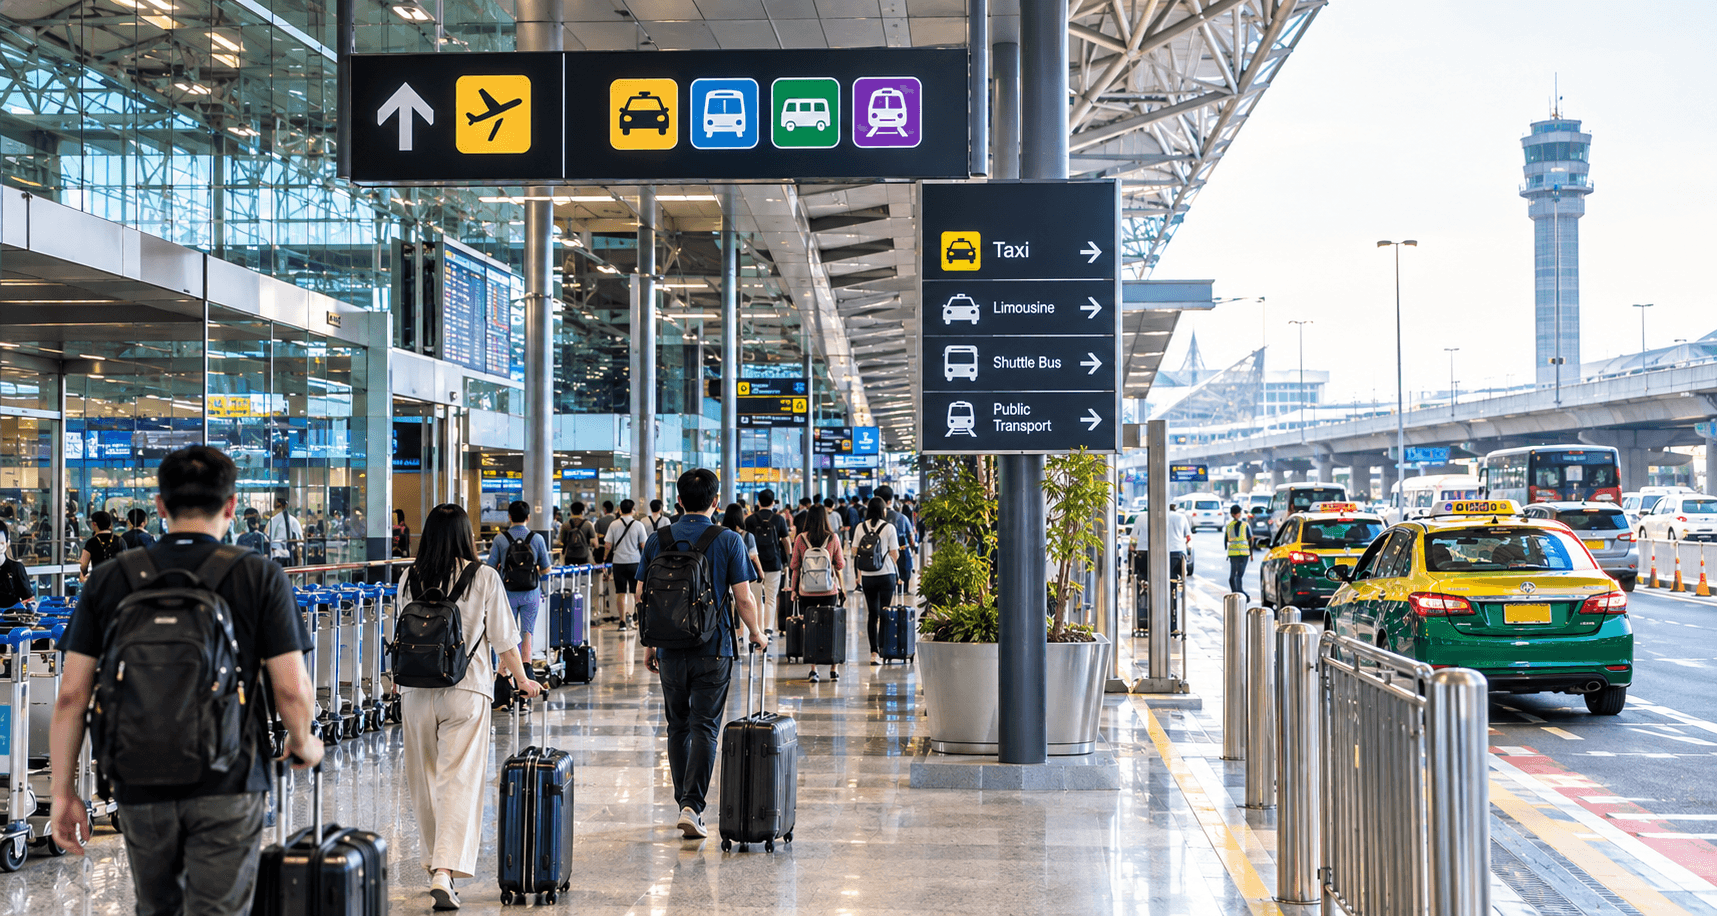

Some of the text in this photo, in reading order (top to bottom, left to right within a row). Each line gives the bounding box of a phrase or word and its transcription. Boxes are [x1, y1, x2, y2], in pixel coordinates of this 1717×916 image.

[993, 241, 1029, 258] Taxi
[993, 300, 1055, 314] Limousine
[993, 355, 1062, 369] Shuttle Bus
[993, 402, 1031, 416] Public
[993, 419, 1052, 434] Transport
